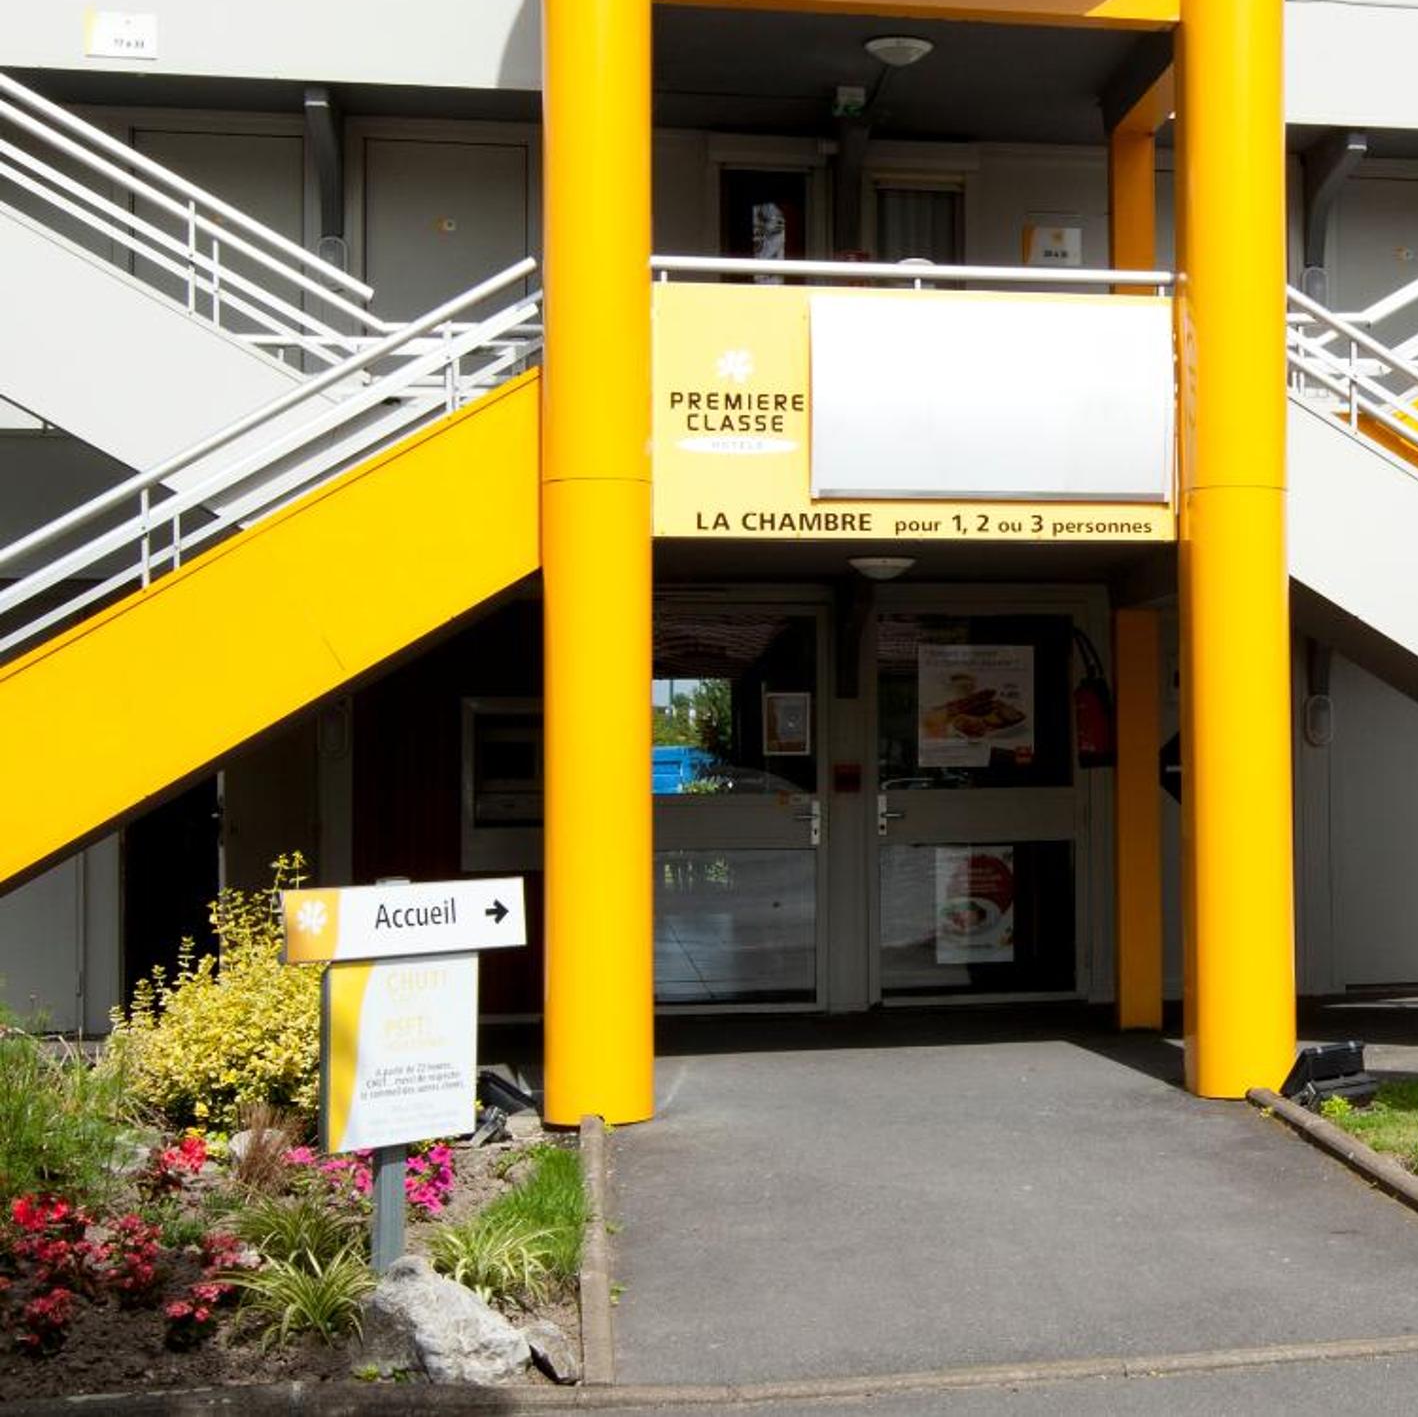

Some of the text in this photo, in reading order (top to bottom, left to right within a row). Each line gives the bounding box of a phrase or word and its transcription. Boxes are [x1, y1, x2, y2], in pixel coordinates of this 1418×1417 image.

[671, 391, 804, 412] PREMIERE
[687, 413, 783, 433] CLASSE
[696, 513, 1152, 536] LA CHAMBRE pour 1, 2 ou 3 personnes
[375, 898, 456, 929] Accueil
